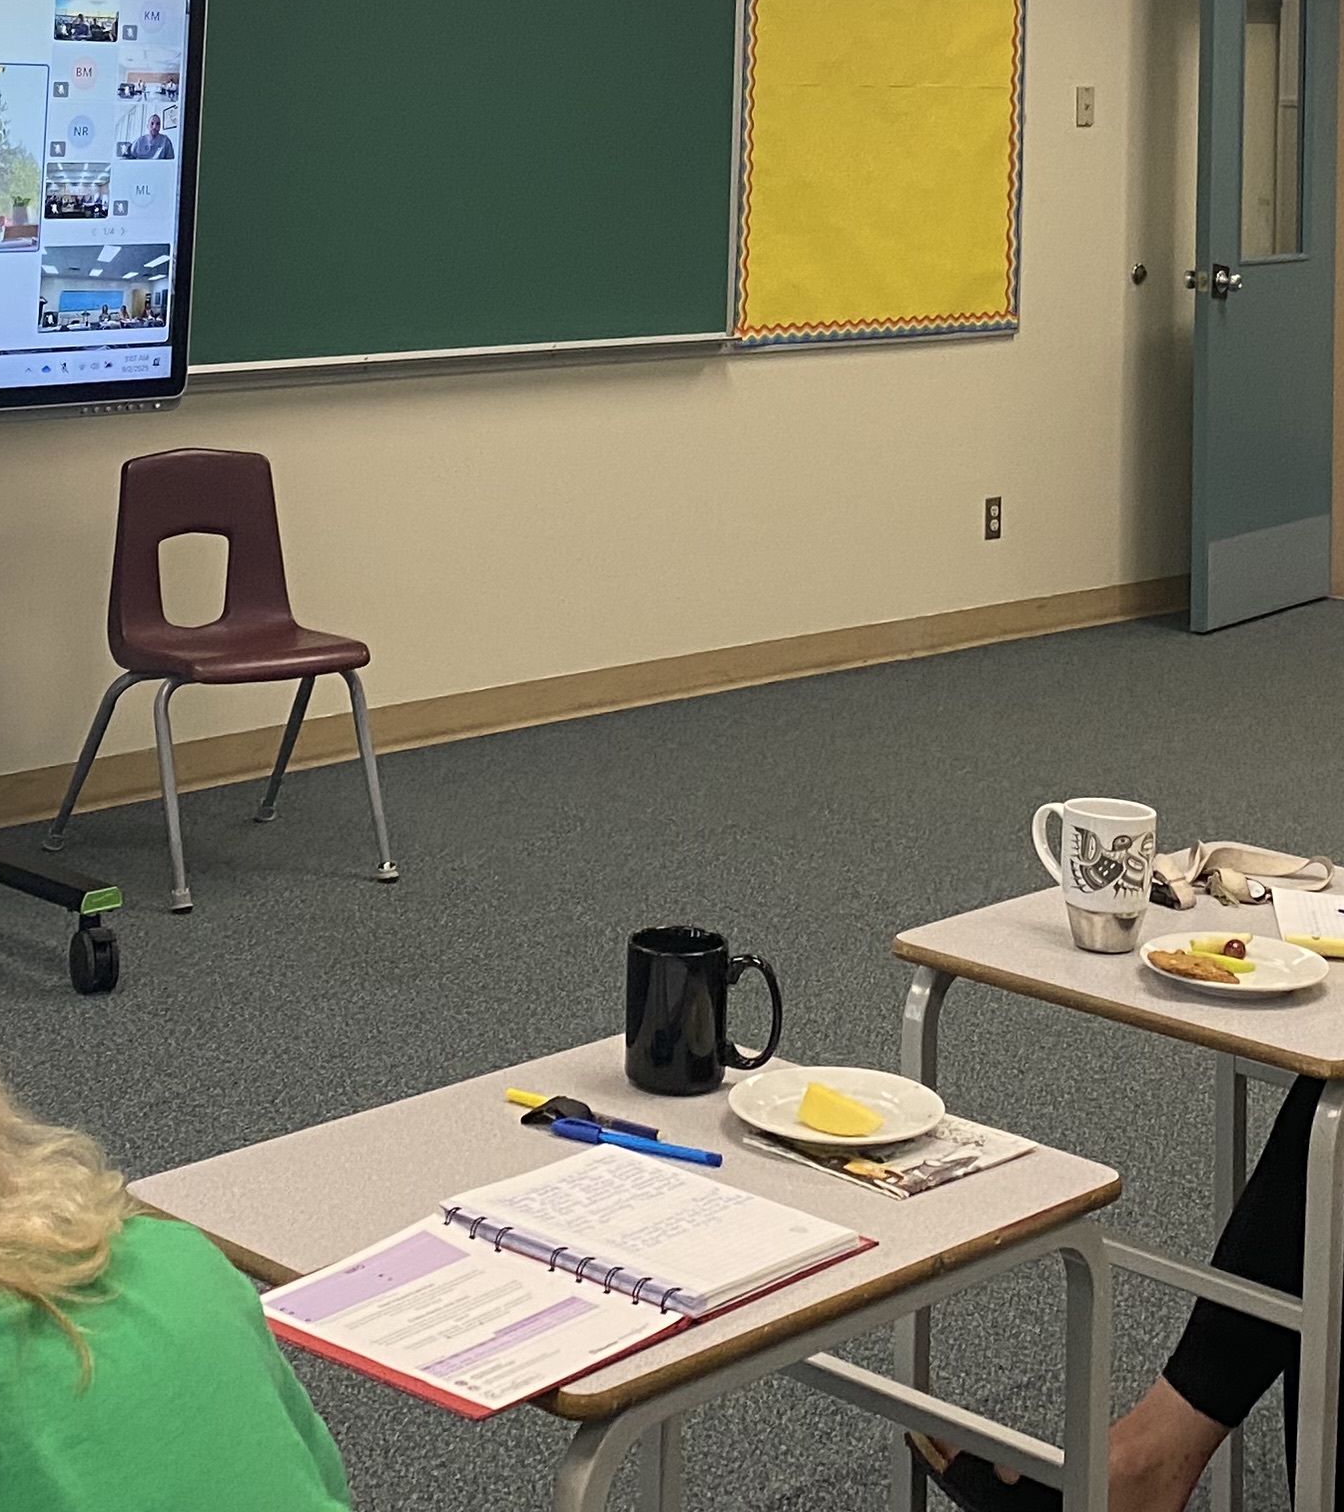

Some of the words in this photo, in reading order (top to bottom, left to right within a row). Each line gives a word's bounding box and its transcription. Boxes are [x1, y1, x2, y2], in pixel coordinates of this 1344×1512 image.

[143, 11, 160, 21] KM
[75, 67, 93, 77] BM
[73, 126, 89, 136] NR
[135, 185, 151, 195] ML
[104, 227, 114, 236] 1/4
